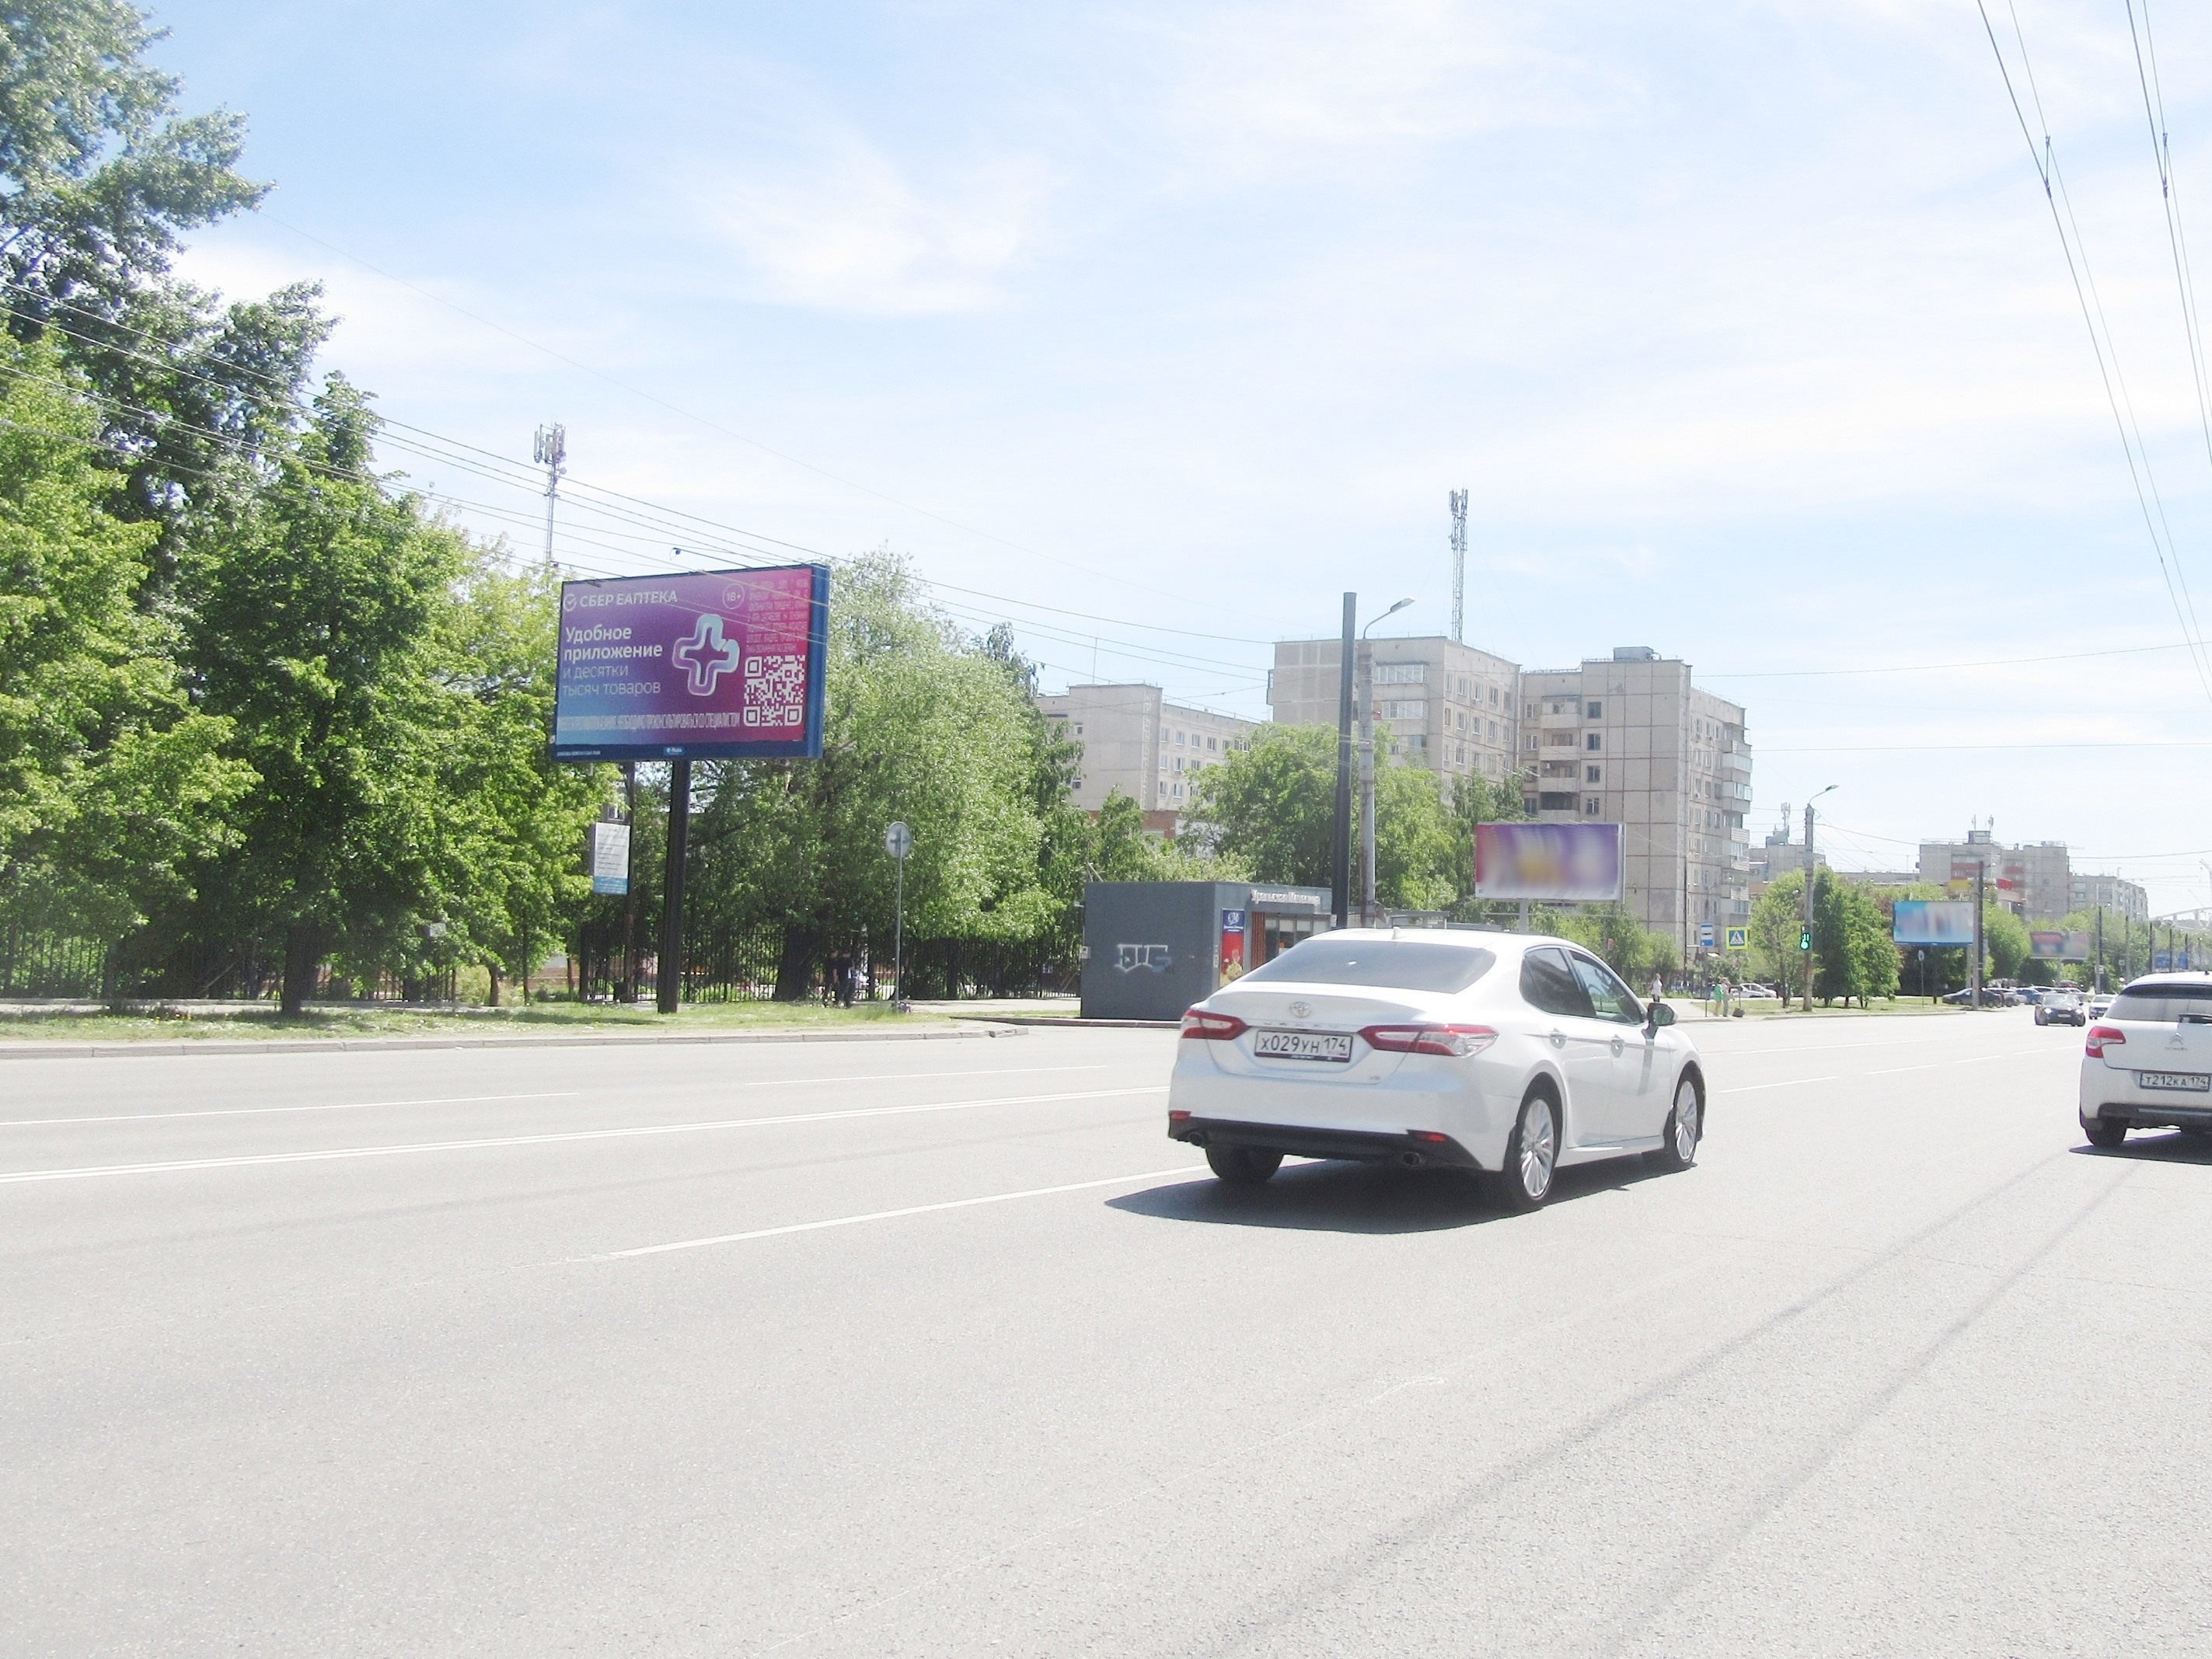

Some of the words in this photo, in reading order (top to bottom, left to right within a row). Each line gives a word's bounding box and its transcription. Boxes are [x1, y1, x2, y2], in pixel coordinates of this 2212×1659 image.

[580, 594, 614, 608] СБЕР
[616, 591, 678, 605] ЕАПТЕКА
[565, 624, 632, 644] Удобное
[564, 644, 663, 664] приложение
[563, 668, 571, 679] и
[574, 665, 629, 680] десятки
[563, 684, 599, 696] тысяч
[603, 681, 661, 697] товаров
[1261, 1035, 1321, 1054] Х029УН
[1324, 1037, 1348, 1051] 174
[2146, 1075, 2187, 1087] Т212КА
[2190, 1076, 2207, 1086] 174
